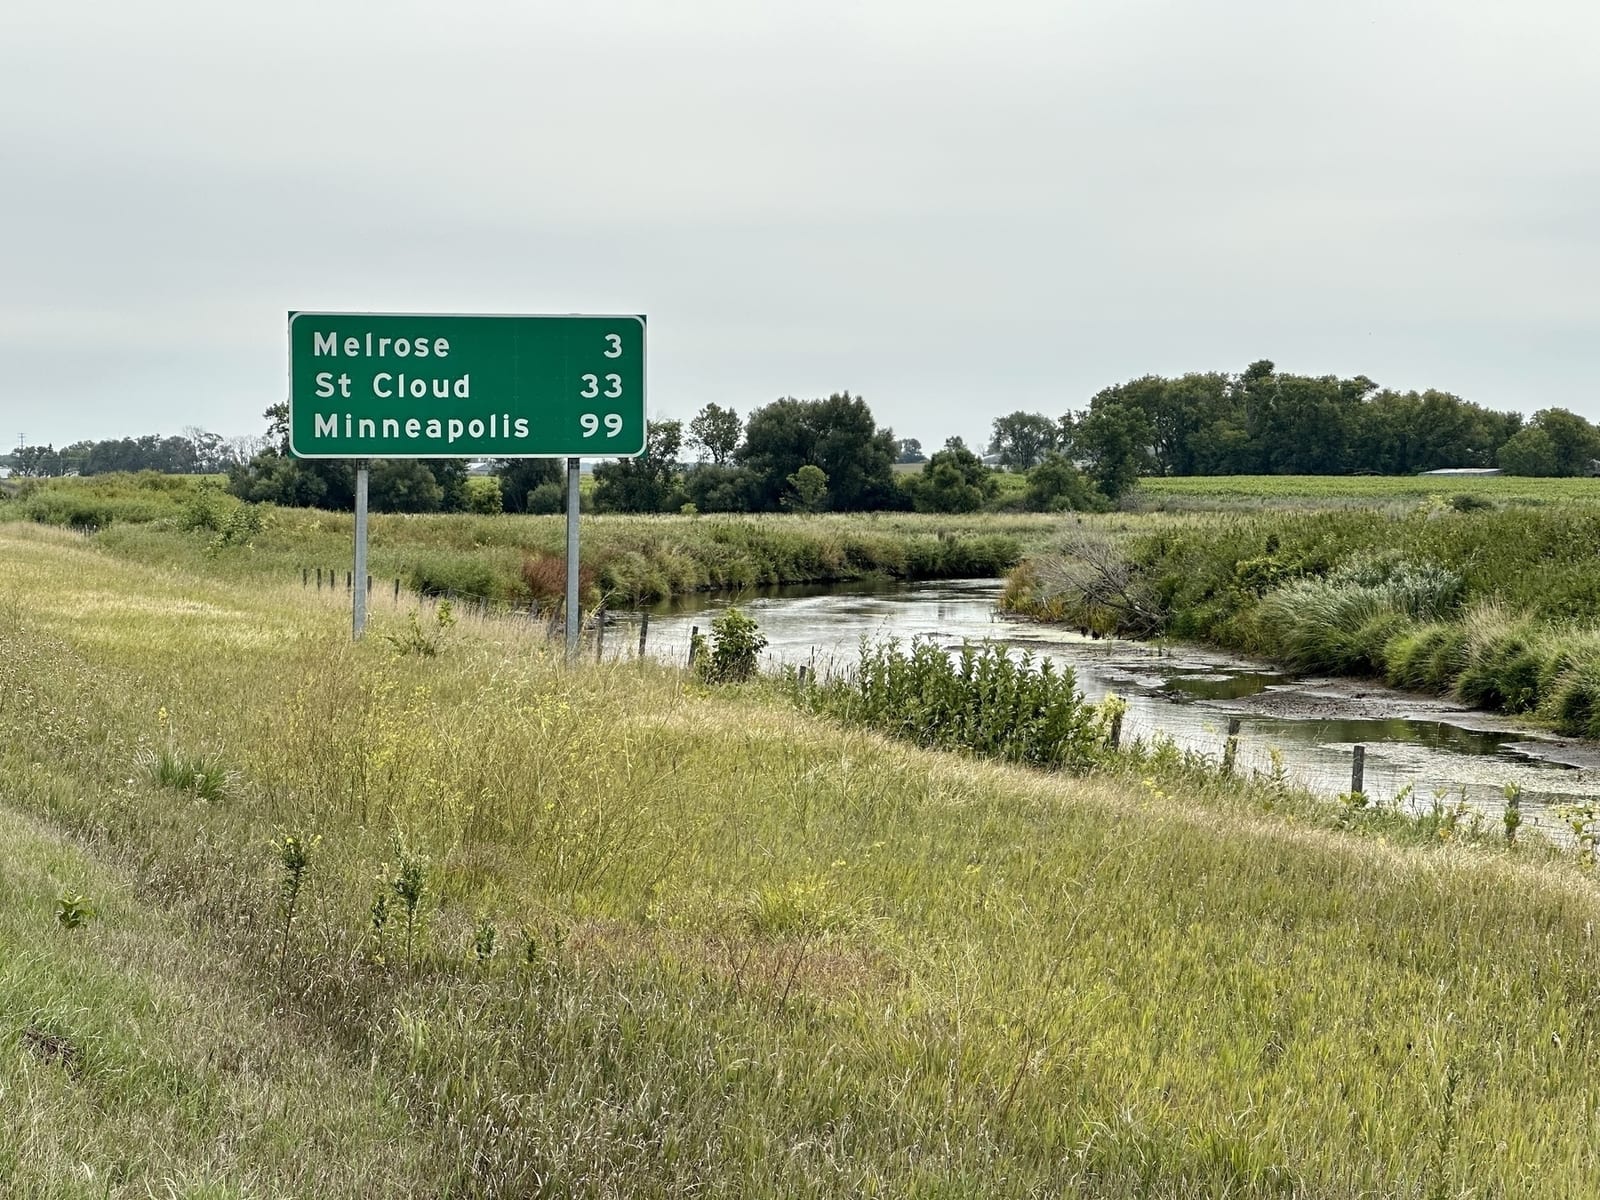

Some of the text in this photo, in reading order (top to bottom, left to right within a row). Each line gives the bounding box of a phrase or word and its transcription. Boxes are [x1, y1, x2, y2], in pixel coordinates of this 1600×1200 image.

[314, 332, 623, 359] Melrose 3
[315, 372, 623, 399] St Cloud 33
[314, 413, 623, 444] Minneapolis 99
